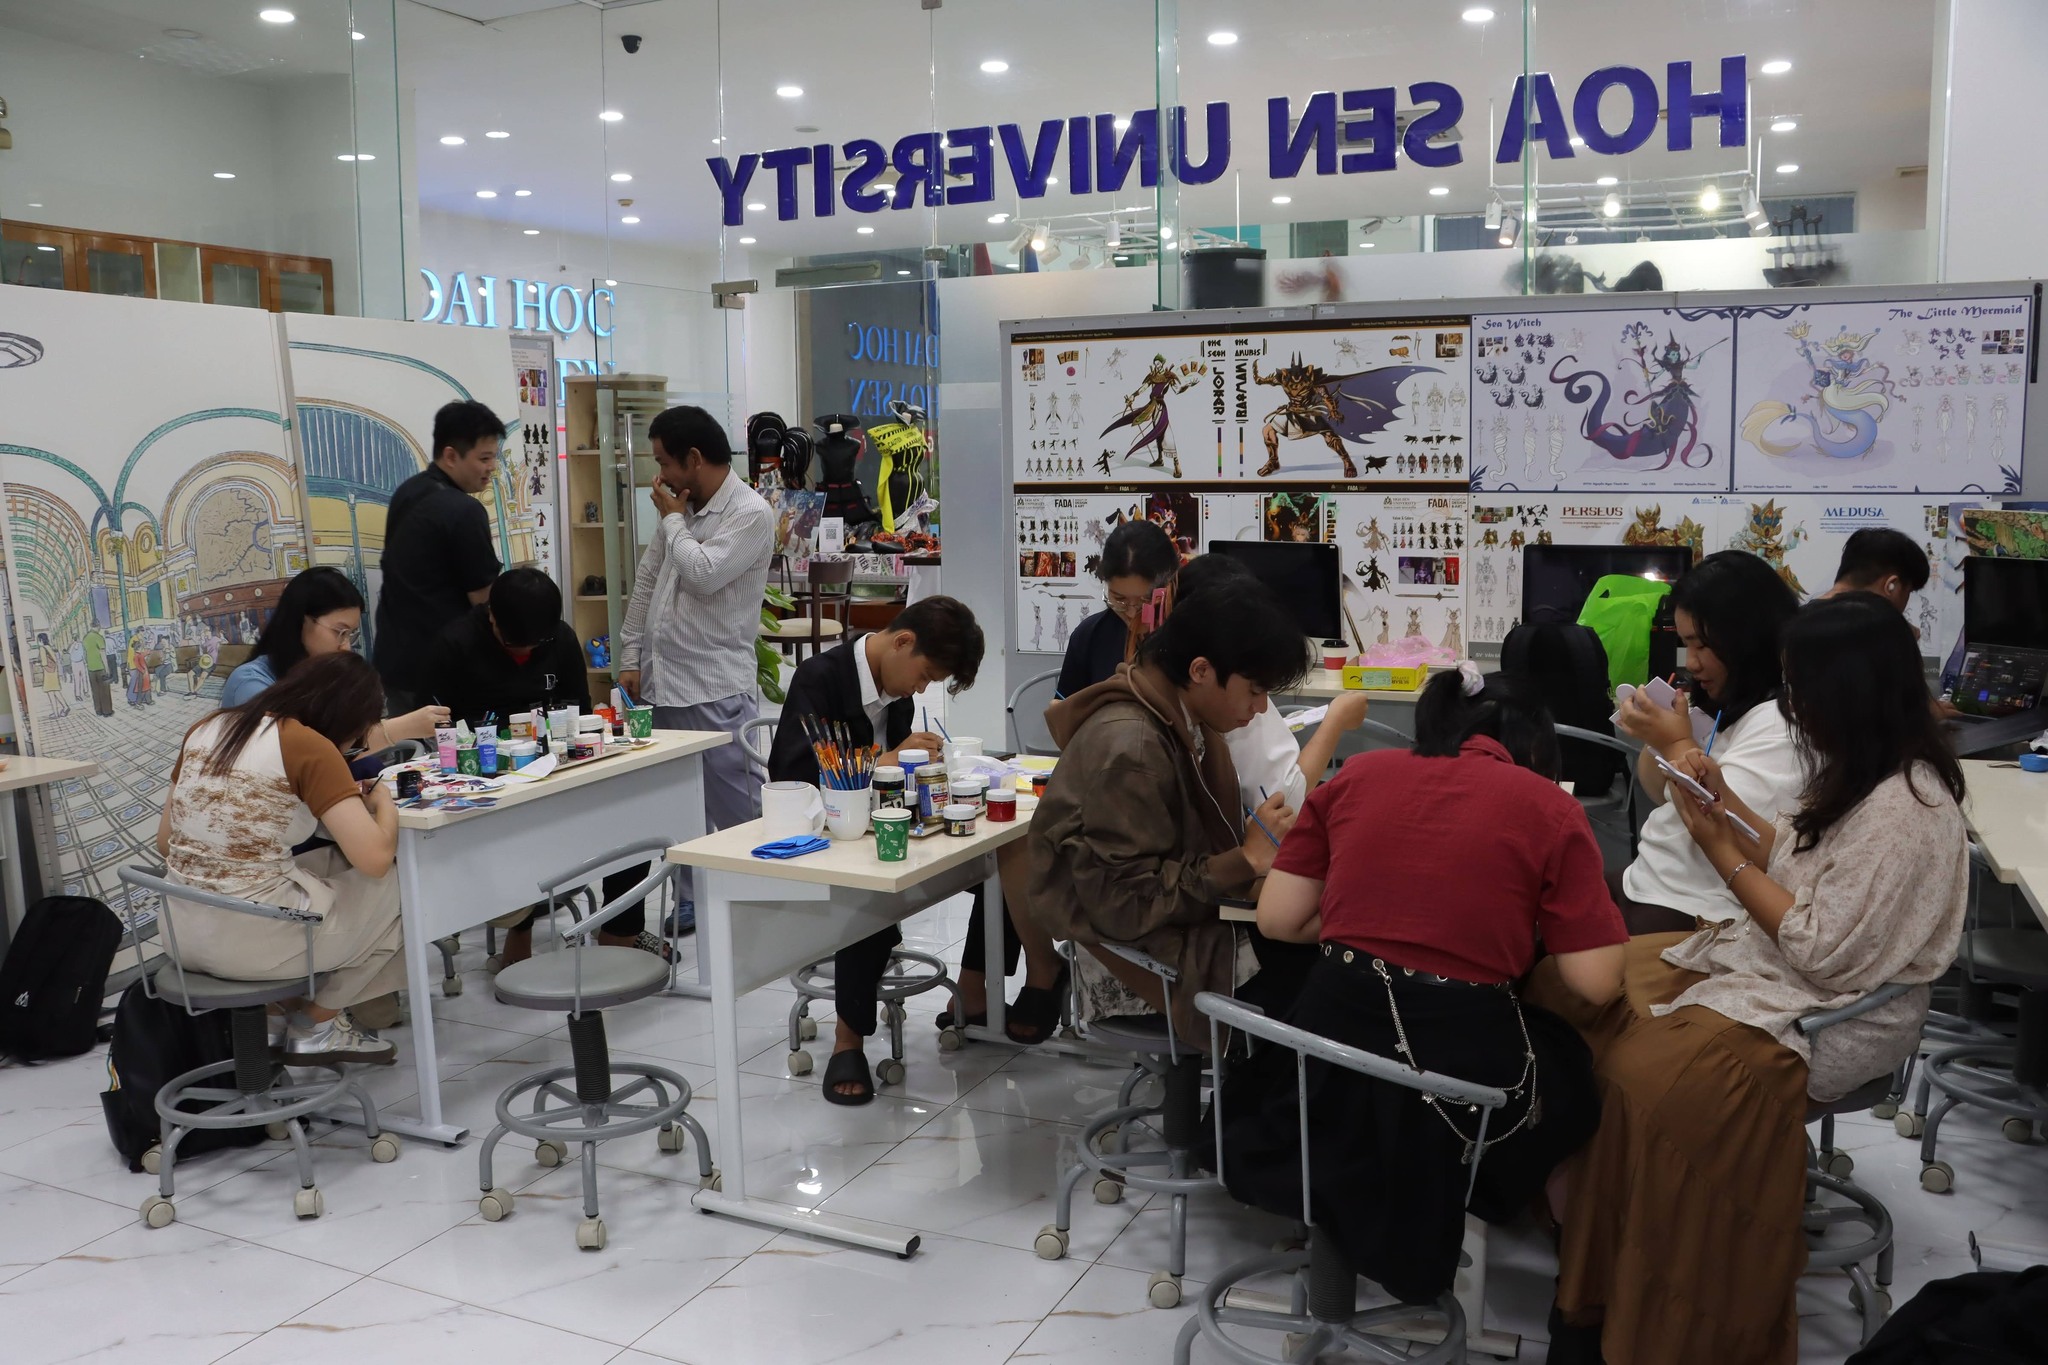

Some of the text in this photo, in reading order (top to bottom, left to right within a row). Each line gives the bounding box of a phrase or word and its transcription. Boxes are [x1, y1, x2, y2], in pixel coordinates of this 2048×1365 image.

[1888, 304, 2023, 321] The Little Mermaid
[1481, 317, 1542, 331] Sea Witch
[1212, 366, 1225, 416] JOKER
[1235, 362, 1248, 418] BATMAN
[1054, 498, 1073, 508] FADA
[1427, 498, 1449, 508] FADA
[1562, 506, 1623, 517] PERSEUS
[1823, 507, 1885, 517] MEDUSA
